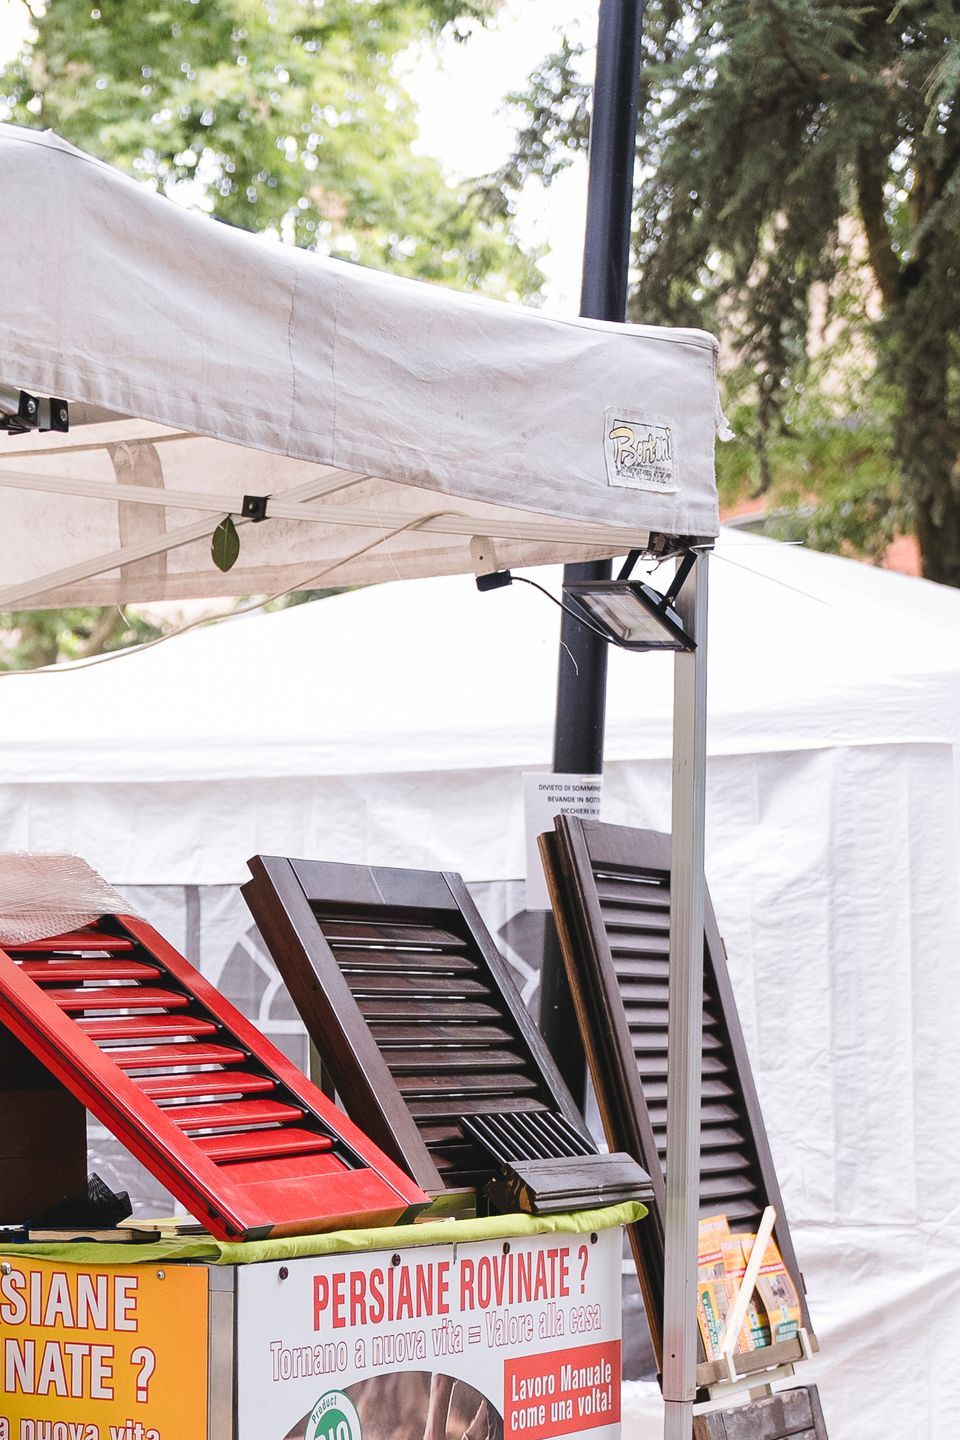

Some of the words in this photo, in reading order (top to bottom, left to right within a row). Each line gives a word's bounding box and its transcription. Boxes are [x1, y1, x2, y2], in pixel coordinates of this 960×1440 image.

[313, 1261, 450, 1332] PERSIANE
[460, 1247, 570, 1312] ROVINATE
[577, 1244, 589, 1294] ?
[269, 1340, 348, 1381] Tornano
[354, 1338, 366, 1369] a
[372, 1329, 427, 1366] nuova
[431, 1317, 464, 1357] vita
[485, 1308, 534, 1348] Valore
[539, 1302, 565, 1339] alla
[569, 1303, 602, 1334] casa
[130, 1346, 157, 1404] ?
[511, 1373, 555, 1402] Lavoro
[560, 1358, 612, 1393] Manuale
[311, 1395, 337, 1425] Product
[511, 1405, 546, 1432] come
[551, 1399, 573, 1424] una
[577, 1384, 612, 1416] volta!
